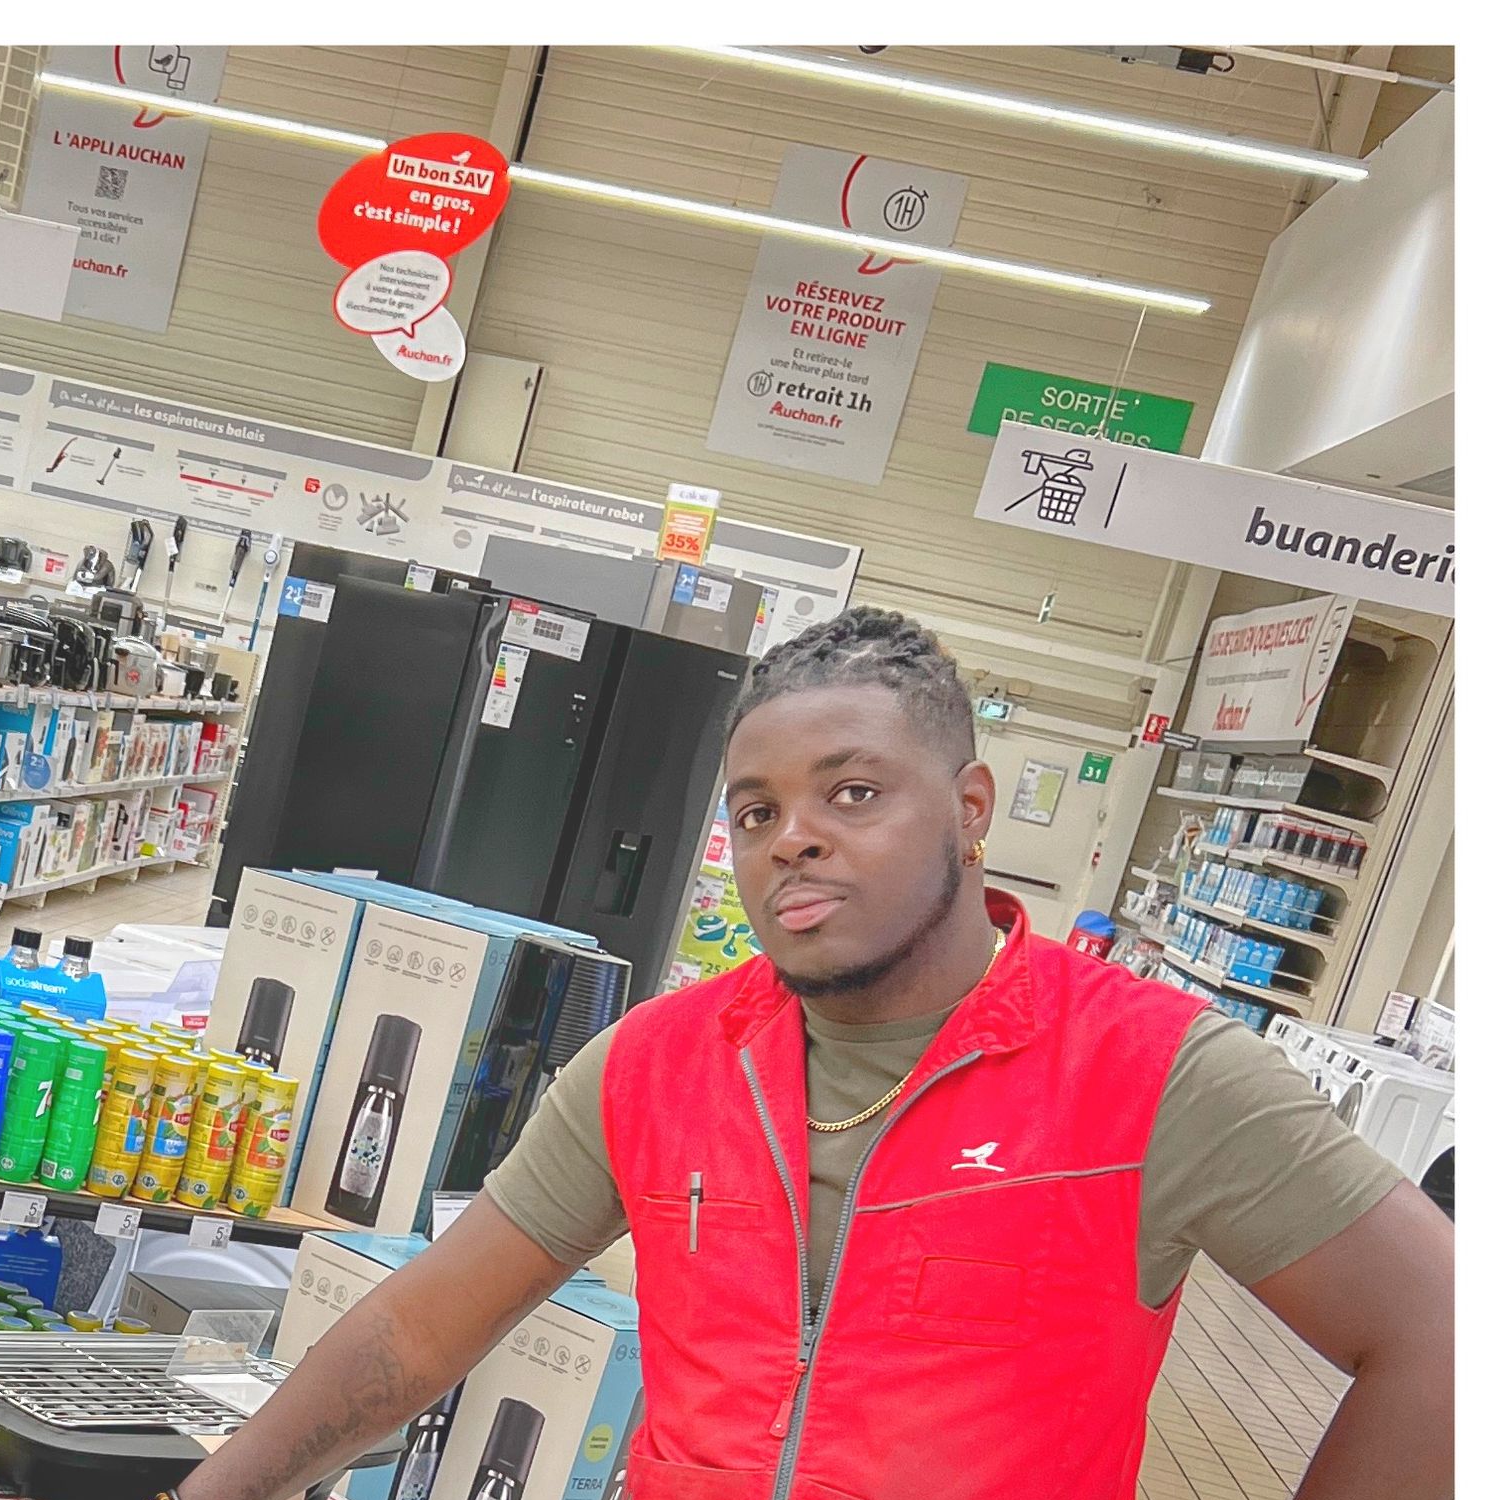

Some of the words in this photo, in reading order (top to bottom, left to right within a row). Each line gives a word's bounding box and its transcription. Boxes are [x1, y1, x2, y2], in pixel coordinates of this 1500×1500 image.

[53, 130, 62, 145] L
[116, 143, 186, 170] AUCHAN
[393, 158, 415, 177] Un
[418, 162, 449, 183] bon
[453, 168, 489, 189] SAV
[67, 200, 89, 215] Tous
[409, 190, 431, 205] en
[433, 193, 475, 216] gros,
[893, 194, 917, 226] 1H
[353, 202, 392, 223] c'est
[393, 207, 451, 234] simple
[72, 258, 129, 279] uchan.fr
[795, 280, 885, 313] RÉSERVEZ
[766, 295, 825, 320] VOTRE
[826, 307, 906, 337] PRODUIT
[790, 320, 815, 337] EN
[817, 325, 869, 349] LIGNE
[397, 344, 453, 367] Auchan.fr
[770, 358, 790, 370] une
[790, 361, 821, 376] heure
[822, 367, 845, 382] plus
[805, 352, 853, 369] retirez-le
[776, 380, 844, 407] retrait
[846, 391, 872, 413] 1h
[1041, 386, 1128, 423] SORTIE
[133, 402, 152, 420] les
[153, 407, 225, 435] aspirateurs
[225, 422, 266, 444] balais
[769, 400, 843, 429] Auchan.fr
[607, 506, 645, 524] robot
[665, 532, 699, 552] 35%
[1244, 506, 1454, 584] buanderi
[4, 975, 68, 995] sodastream
